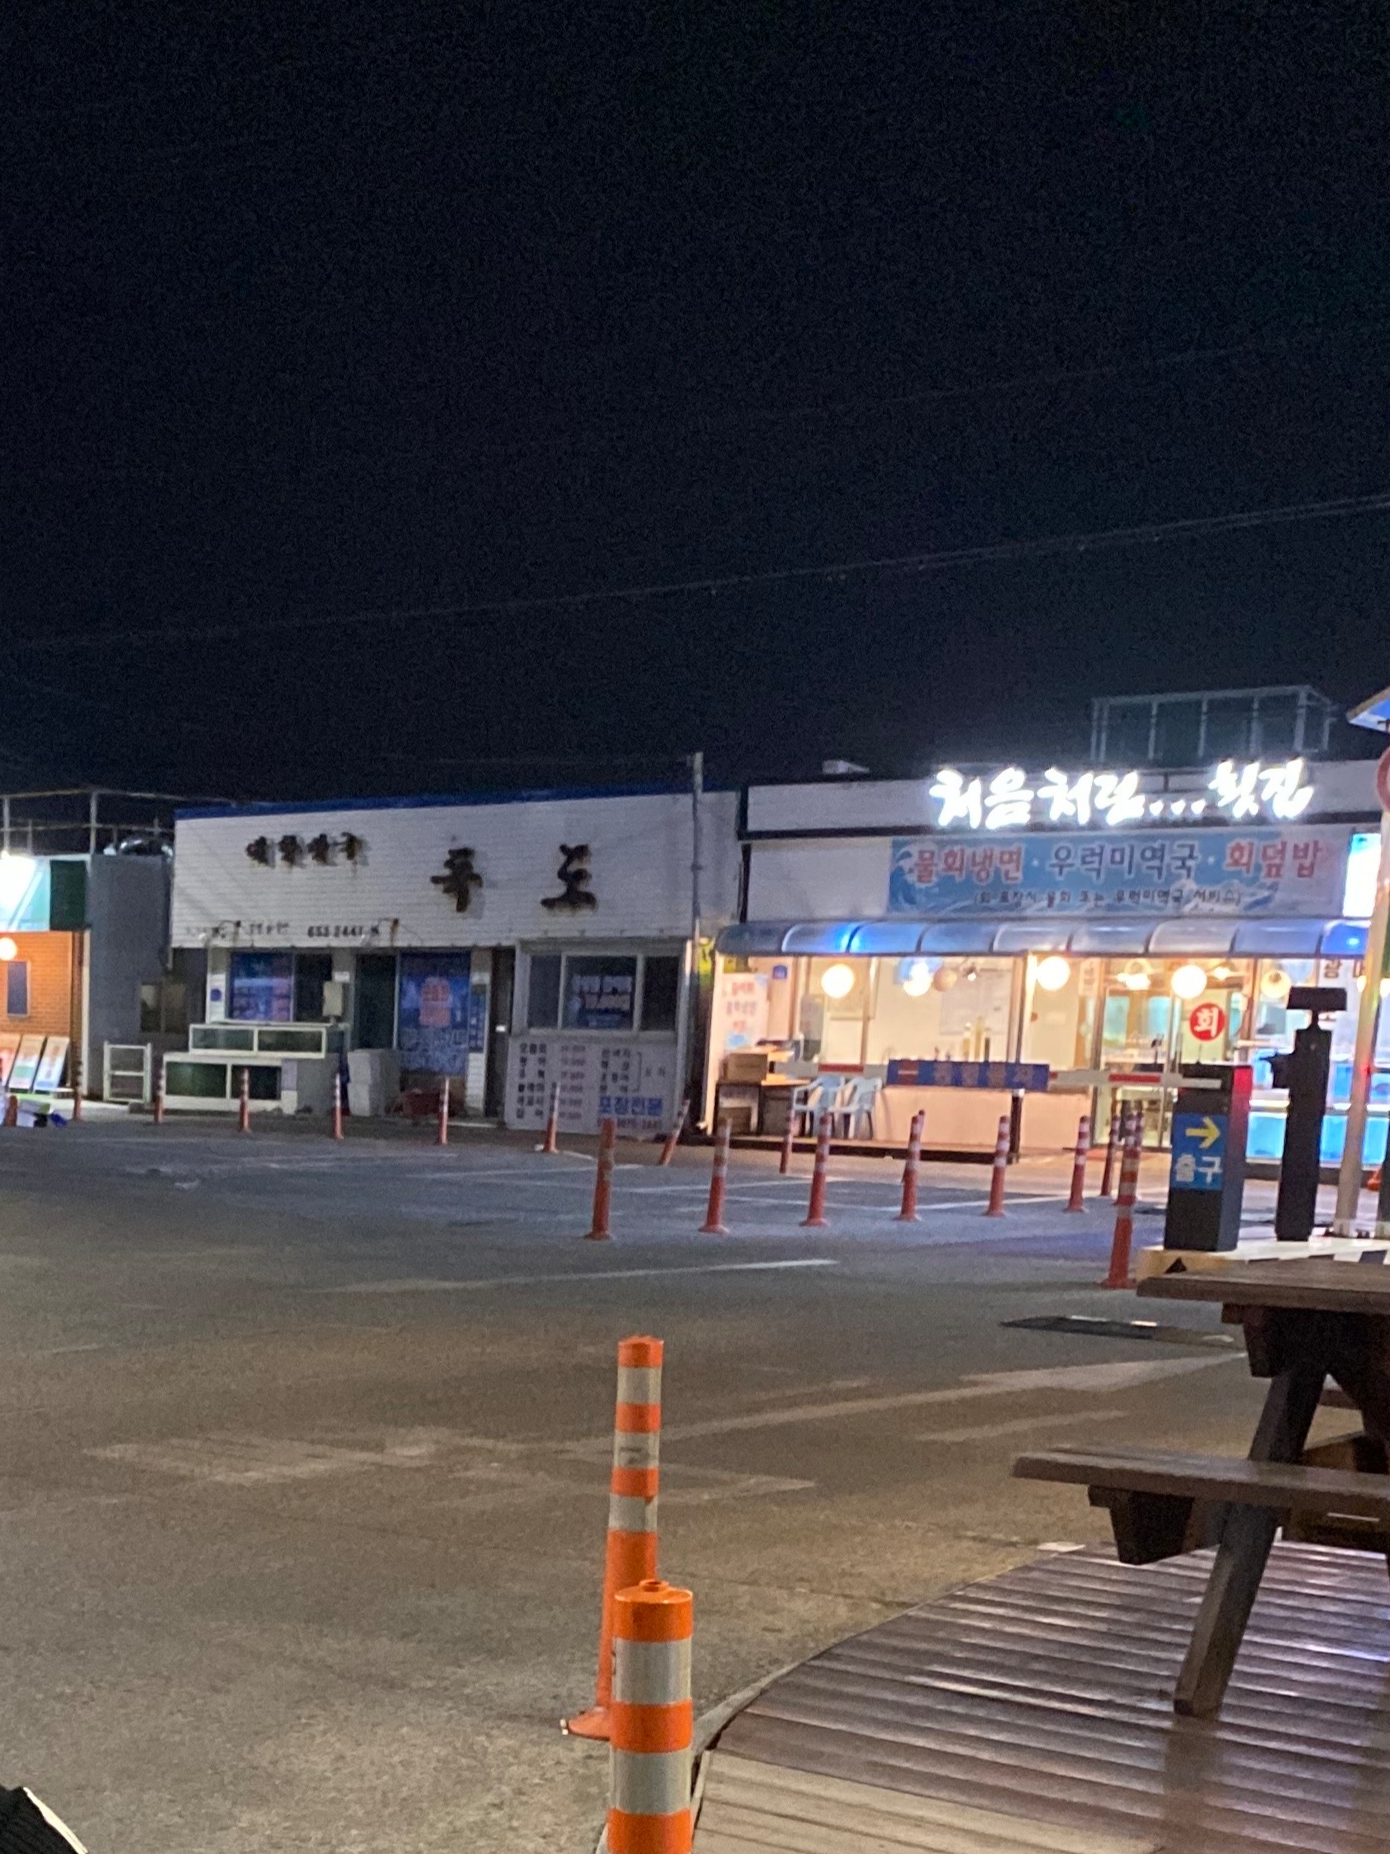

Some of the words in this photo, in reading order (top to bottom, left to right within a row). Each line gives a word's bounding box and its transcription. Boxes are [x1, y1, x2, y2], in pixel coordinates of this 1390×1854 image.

[914, 845, 1023, 883] 물회냉면
[1049, 842, 1199, 880] 우럭미역국
[1225, 841, 1322, 879] 회덮밥
[1194, 1006, 1219, 1038] 회
[1175, 1153, 1223, 1183] 출구
